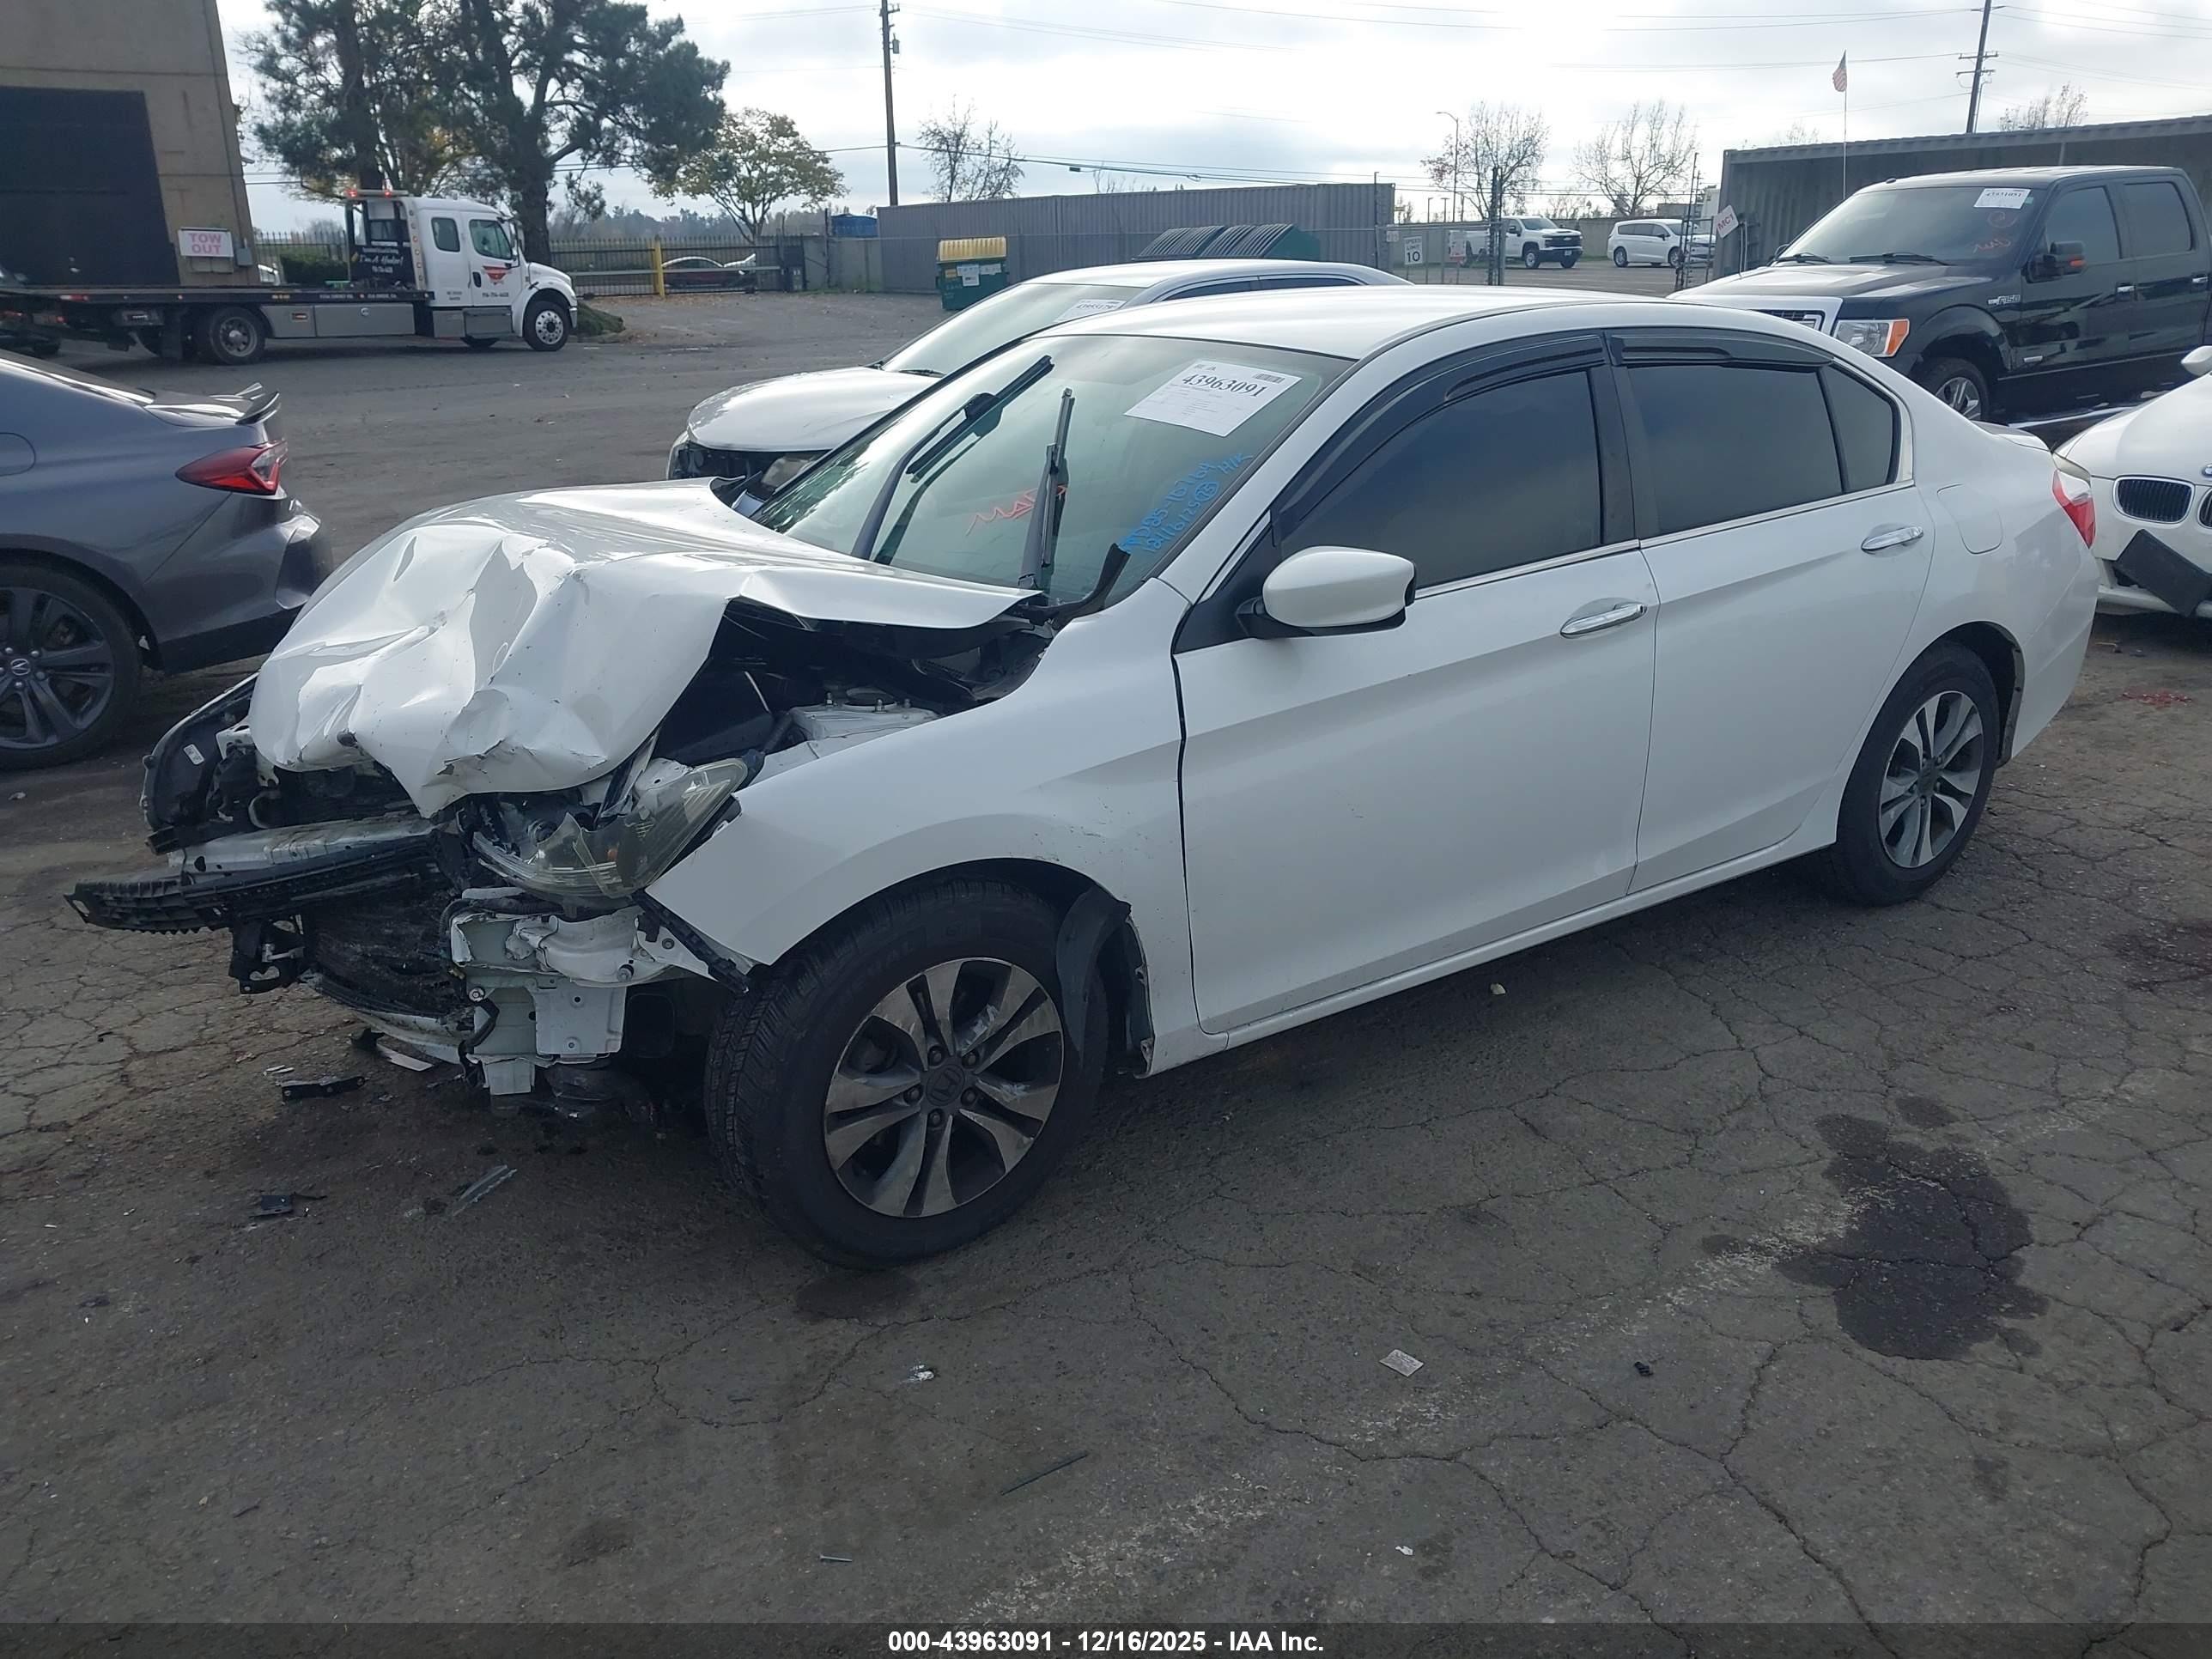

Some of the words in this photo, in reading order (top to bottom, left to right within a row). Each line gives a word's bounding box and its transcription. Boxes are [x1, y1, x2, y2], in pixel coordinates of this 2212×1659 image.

[188, 233, 222, 244] TOW
[191, 243, 222, 255] OUT
[1407, 251, 1420, 263] 10
[1182, 374, 1268, 398] 43963091
